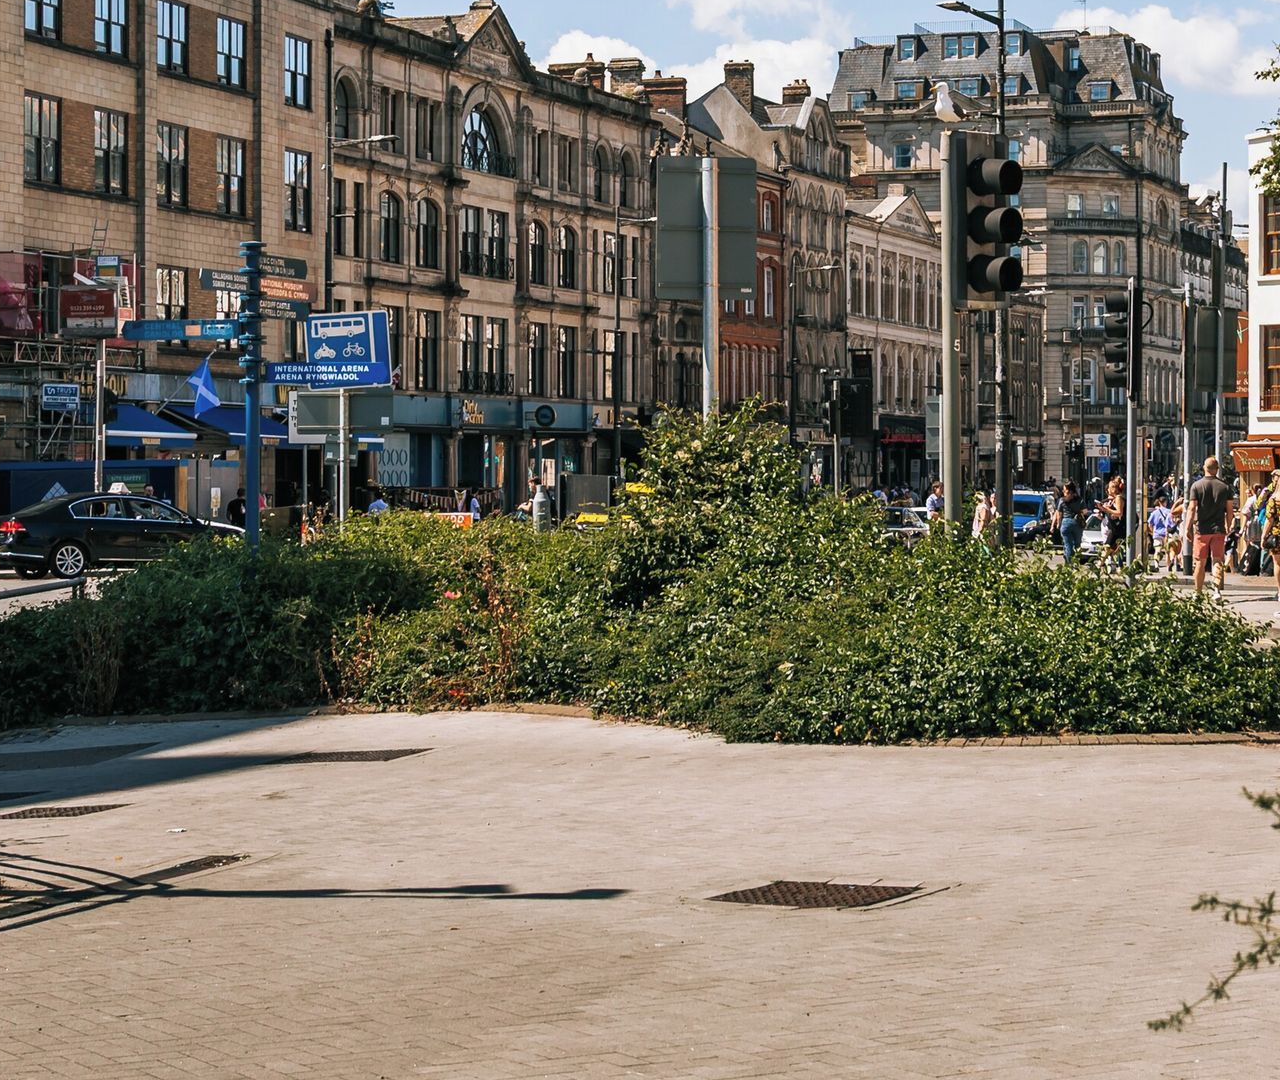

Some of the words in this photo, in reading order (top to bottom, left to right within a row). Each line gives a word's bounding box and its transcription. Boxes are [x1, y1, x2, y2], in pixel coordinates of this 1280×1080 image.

[261, 279, 283, 289] NATIONAL
[283, 281, 303, 291] MUSEUM
[954, 339, 961, 352] 5
[274, 365, 337, 373] INTERNATIONAL
[341, 365, 370, 373] ARENA
[274, 373, 303, 381] ARENA
[305, 373, 359, 381] RYNGWIADOL
[56, 386, 76, 395] TRUST
